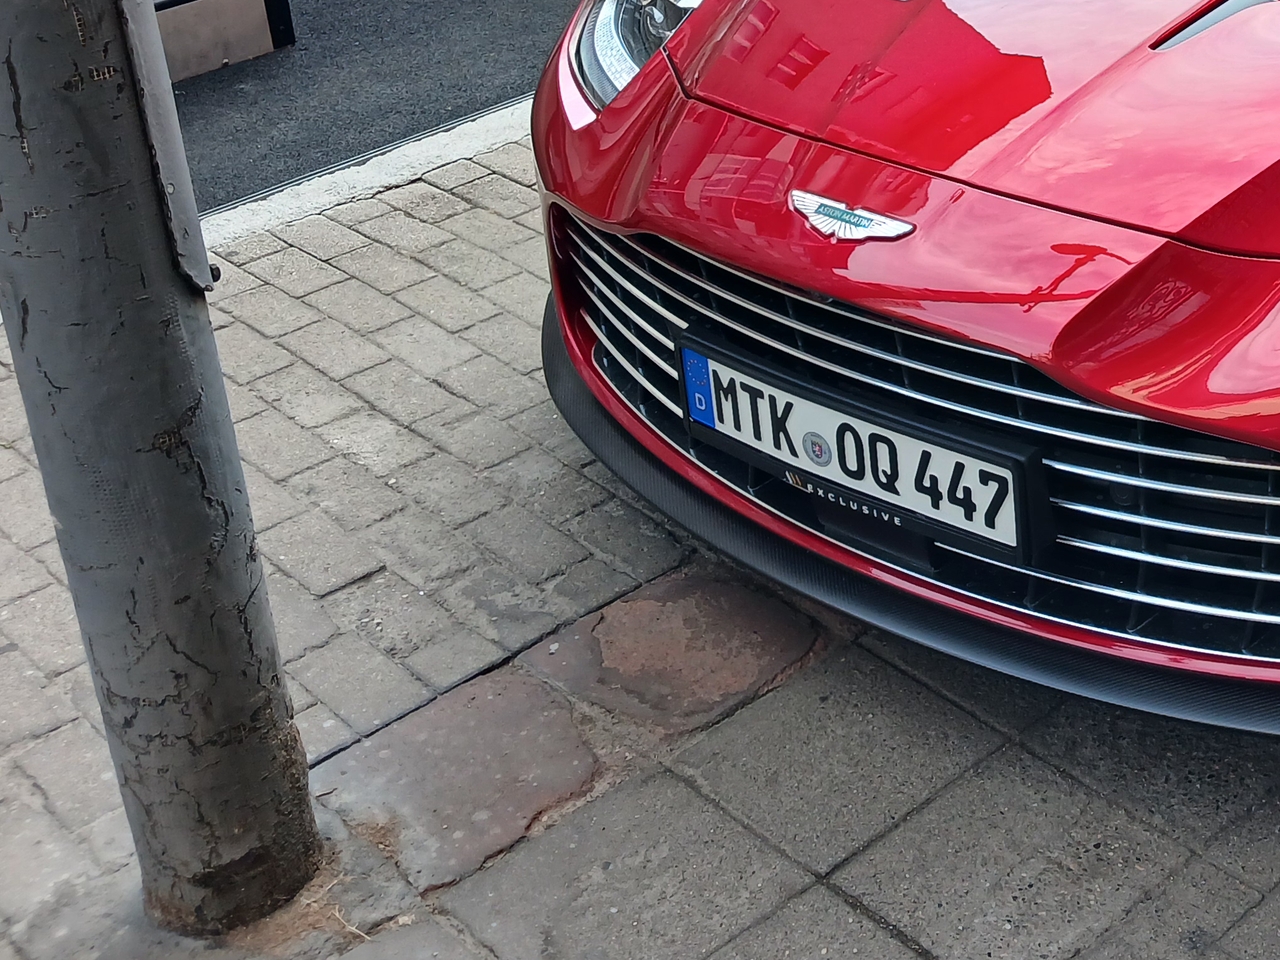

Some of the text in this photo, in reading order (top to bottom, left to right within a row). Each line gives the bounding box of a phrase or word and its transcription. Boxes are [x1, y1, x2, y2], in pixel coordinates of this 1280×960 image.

[817, 206, 871, 227] ASTON MARTIN
[695, 393, 706, 410] D
[712, 368, 1009, 530] MTK OQ 447
[807, 483, 901, 526] EXCLUSIVE
